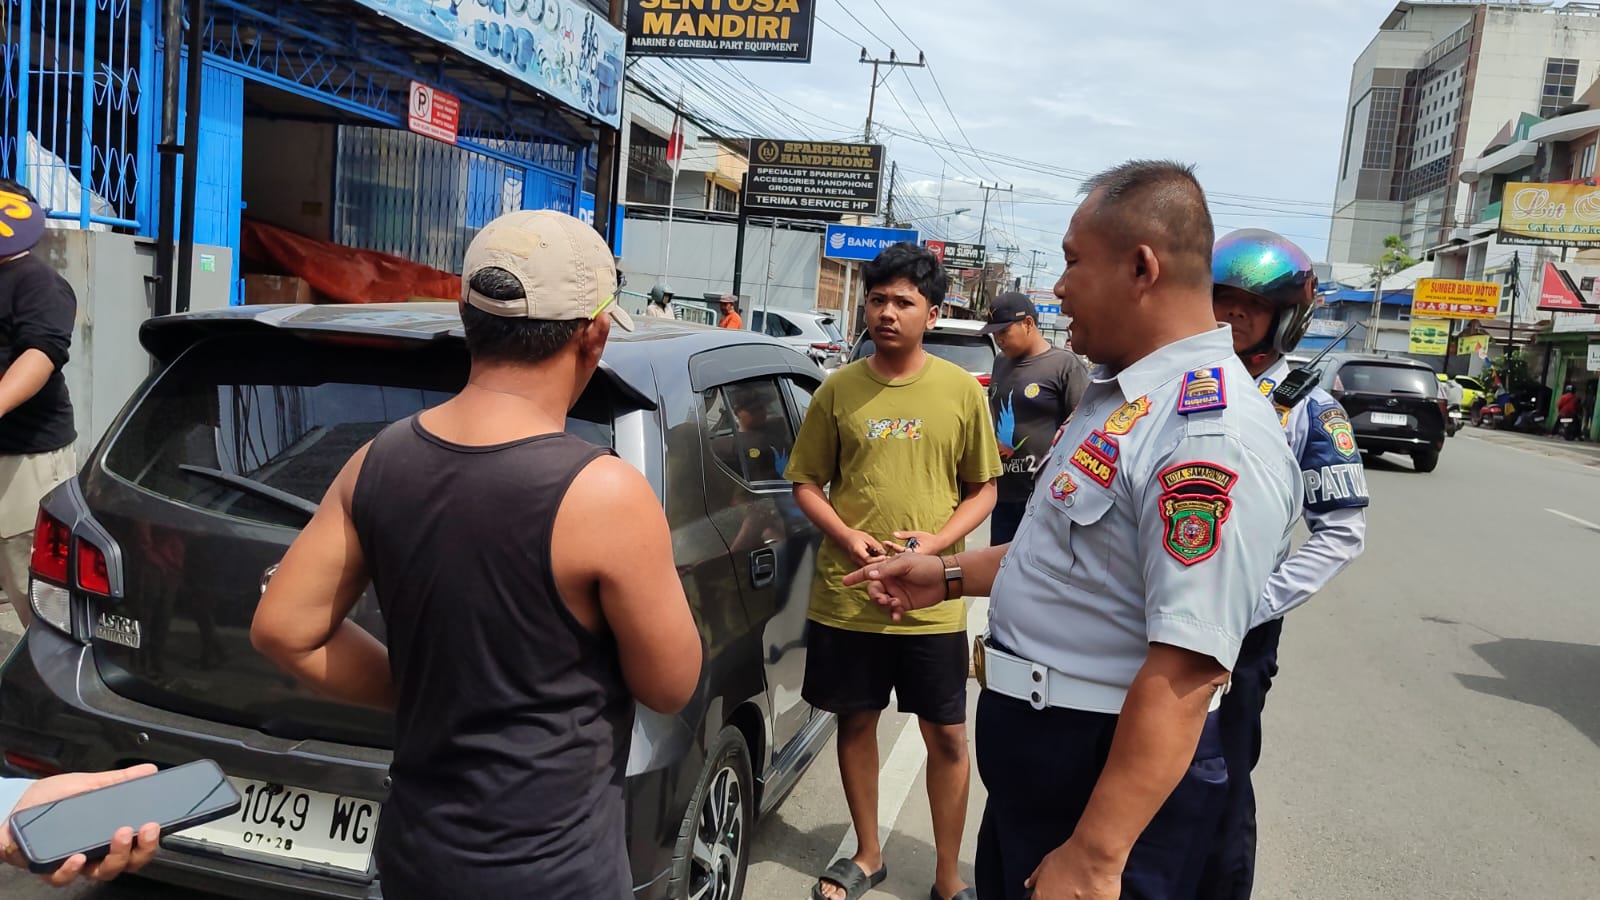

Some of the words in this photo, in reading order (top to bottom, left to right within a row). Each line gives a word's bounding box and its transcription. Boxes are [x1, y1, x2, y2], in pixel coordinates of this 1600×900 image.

[643, 12, 791, 40] MANDIRI
[632, 37, 667, 47] MARINE
[669, 39, 676, 47] &
[678, 39, 718, 49] GENERAL
[719, 41, 744, 50] PART
[744, 42, 799, 52] EQUIPMENT
[784, 142, 871, 157] SPAREPART
[780, 153, 873, 168] HANDPHONE
[757, 167, 808, 177] SPECIALIST
[809, 170, 862, 180] SPAREPART
[753, 175, 815, 185] ACCESSORIES
[817, 179, 874, 189] HANDPHONE
[768, 184, 802, 193] GROSIR
[804, 186, 823, 194] DAN
[825, 187, 856, 196] RETAIL
[755, 195, 798, 206] TERIMA
[800, 197, 849, 209] SERVICE
[852, 200, 869, 210] HP
[847, 237, 878, 249] BANK
[956, 247, 979, 259] SURYA
[1430, 282, 1456, 294] SUMBER
[1457, 284, 1474, 295] BARU
[1475, 285, 1497, 297] MOTOR
[1074, 448, 1111, 481] DISHUB
[1166, 469, 1185, 484] KOTA
[1187, 467, 1229, 486] SAMARINDA
[242, 785, 310, 831] 1049
[329, 796, 372, 844] WG
